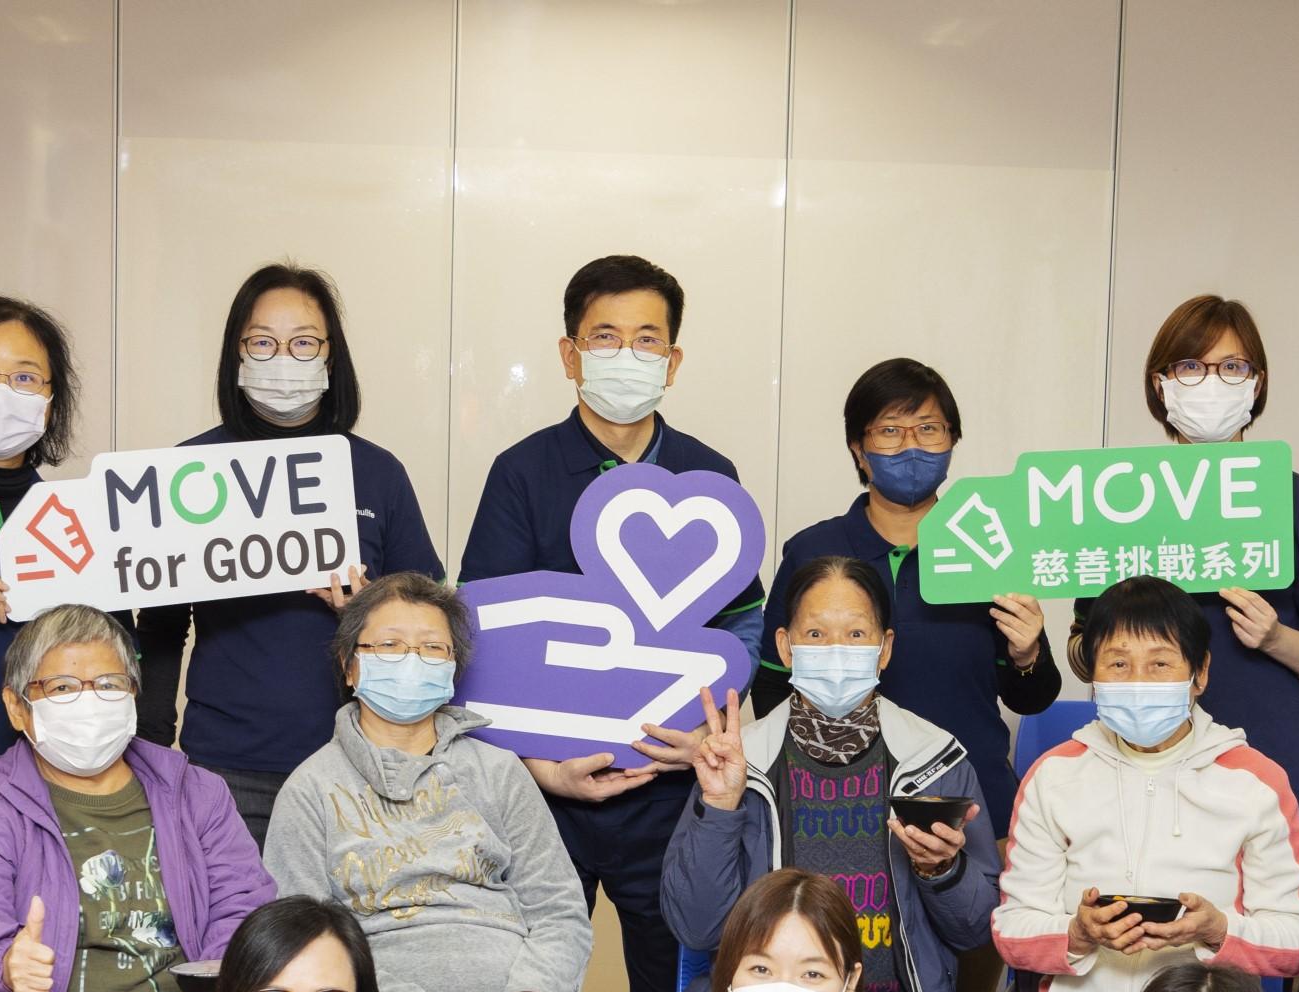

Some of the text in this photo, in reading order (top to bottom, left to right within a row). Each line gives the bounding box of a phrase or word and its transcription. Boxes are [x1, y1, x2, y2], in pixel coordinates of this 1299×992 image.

[105, 452, 327, 532] MOVE
[1027, 456, 1262, 527] MOVE
[113, 527, 346, 594] for GOOD
[1030, 540, 1280, 587] 慈善挑戰系列
